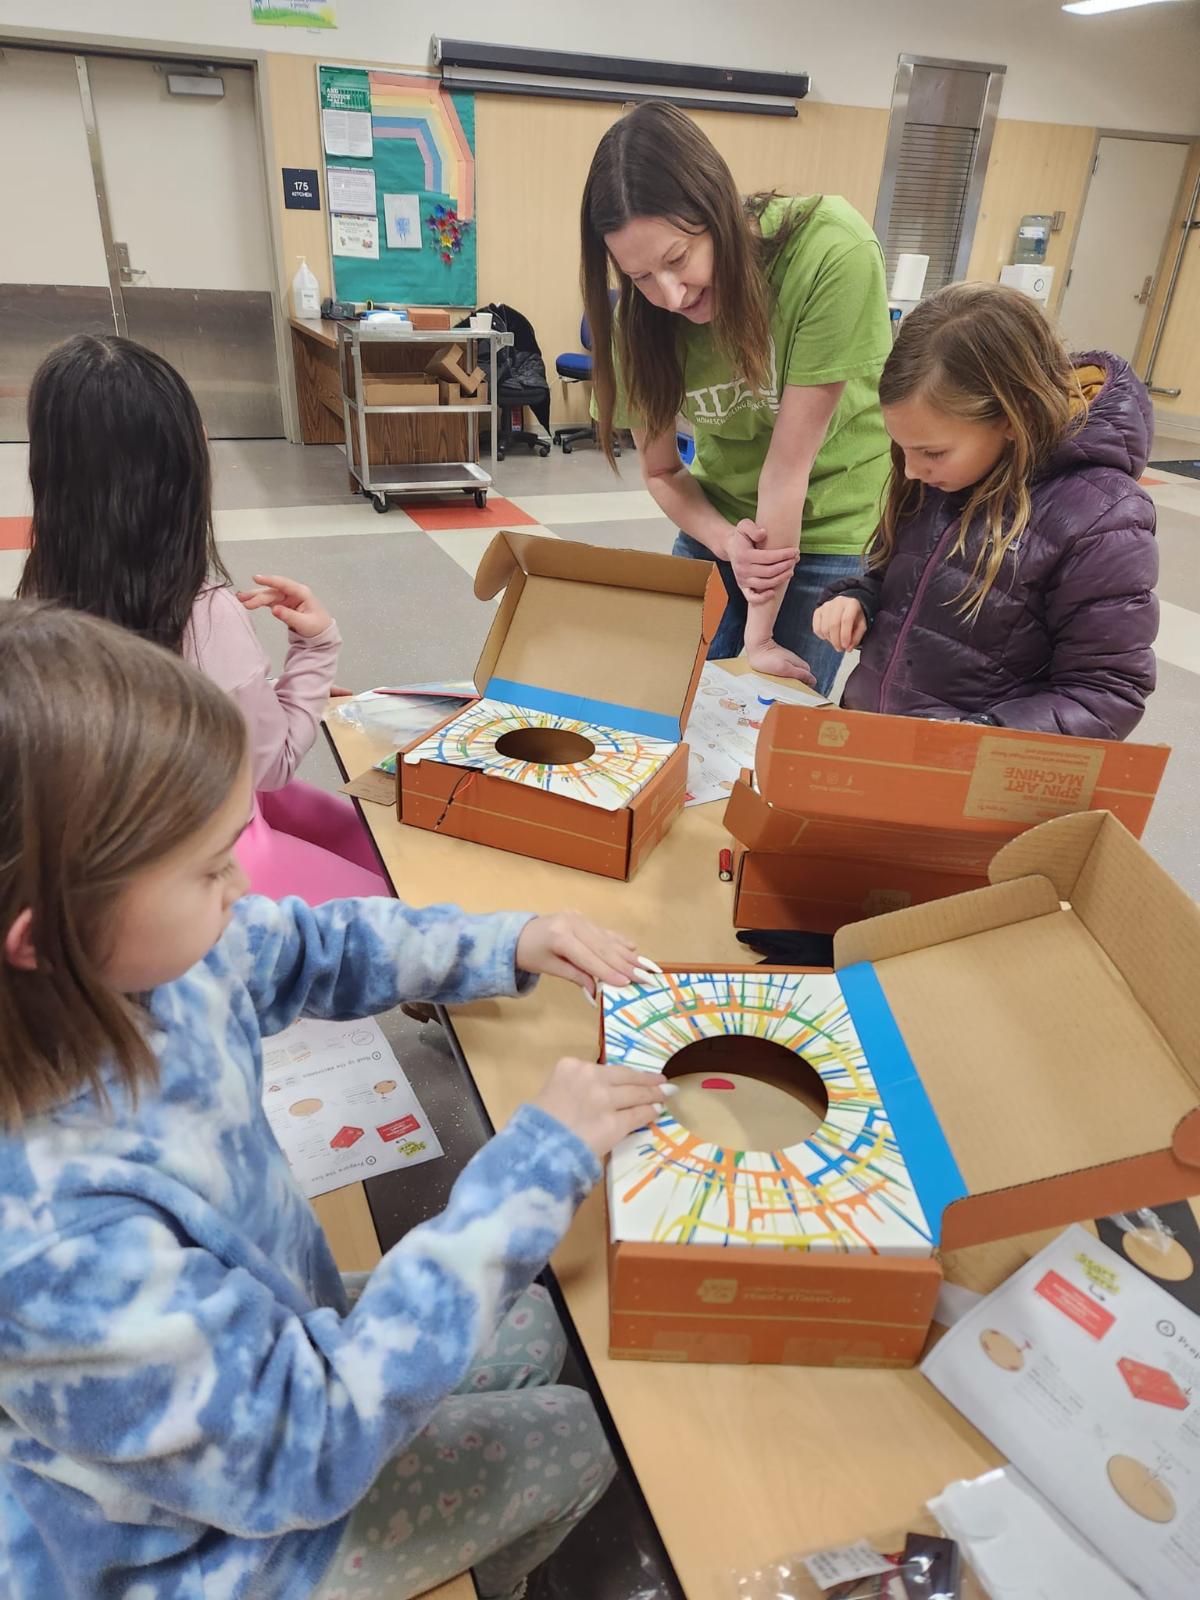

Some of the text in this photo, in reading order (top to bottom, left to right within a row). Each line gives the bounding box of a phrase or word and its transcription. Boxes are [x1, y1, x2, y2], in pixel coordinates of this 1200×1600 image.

[294, 181, 309, 191] 175
[1003, 767, 1085, 786] MACHINE
[1003, 780, 1081, 799] SPIN ART
